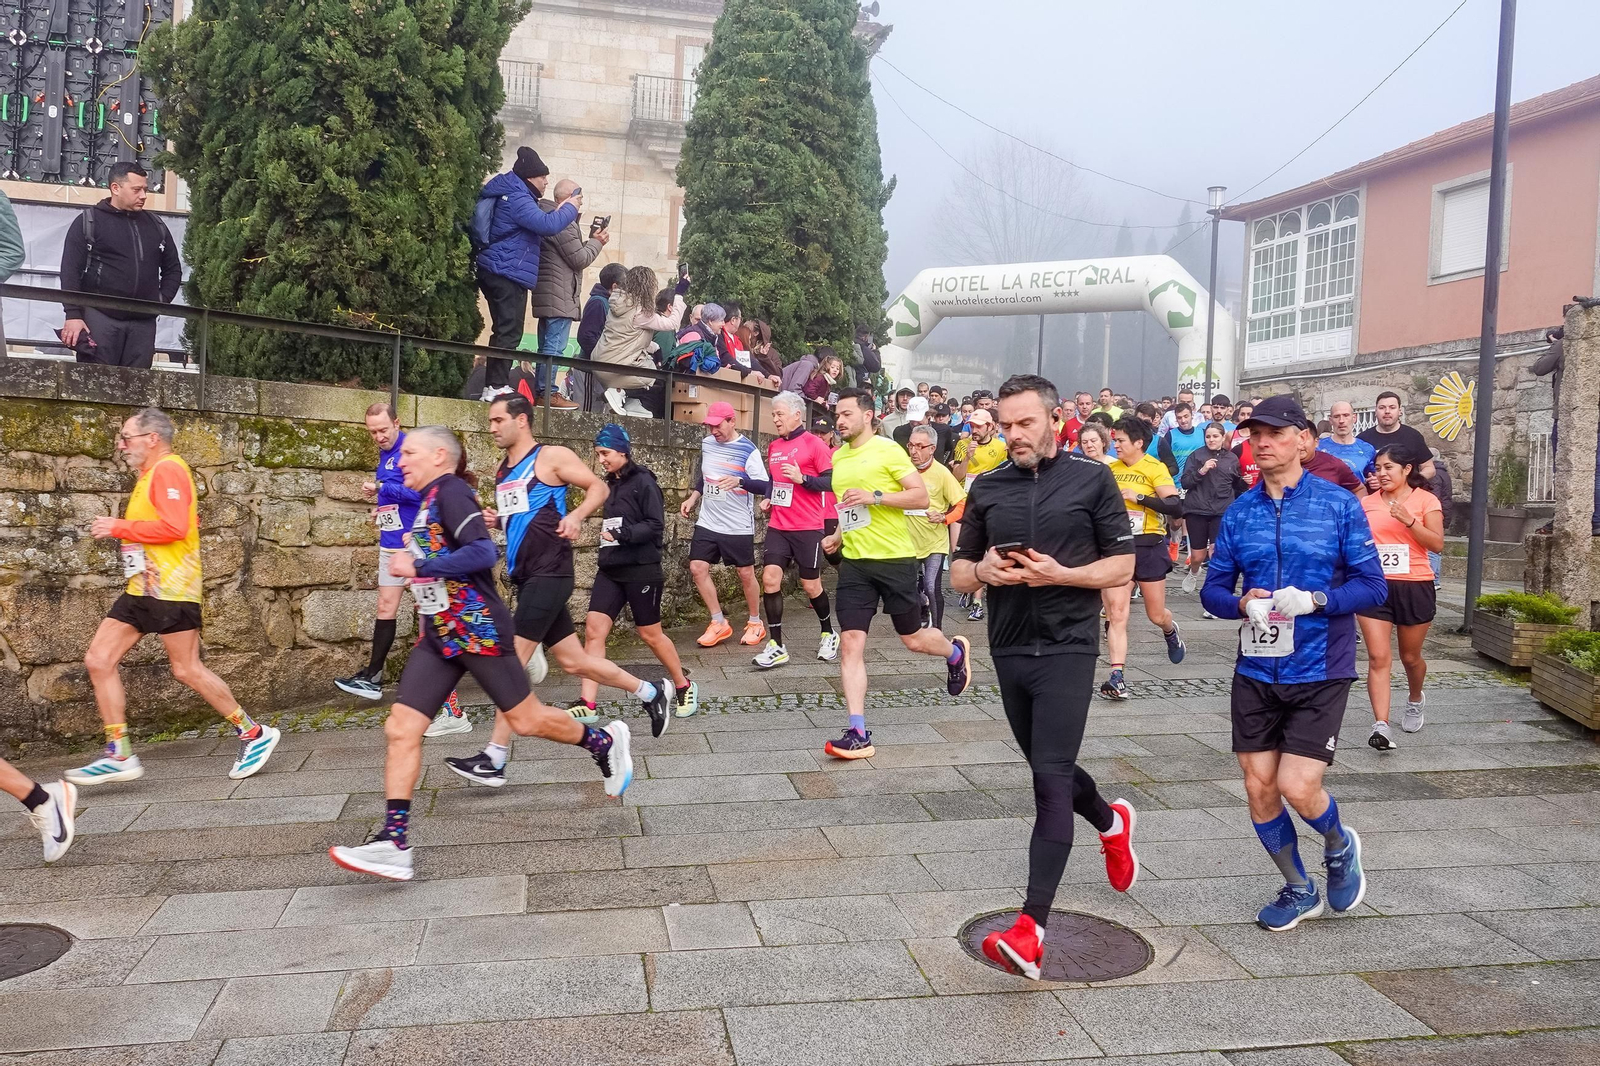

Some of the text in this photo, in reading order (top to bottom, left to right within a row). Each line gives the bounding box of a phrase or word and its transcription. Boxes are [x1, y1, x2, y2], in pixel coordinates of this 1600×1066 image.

[931, 264, 1135, 293] HOTEL LA RECTRAL
[932, 293, 1042, 306] www.hotelrectoral.com
[706, 484, 720, 495] 113
[774, 489, 787, 500] 140
[844, 508, 858, 523] 76
[1382, 553, 1400, 566] 23
[1251, 625, 1279, 644] 129
